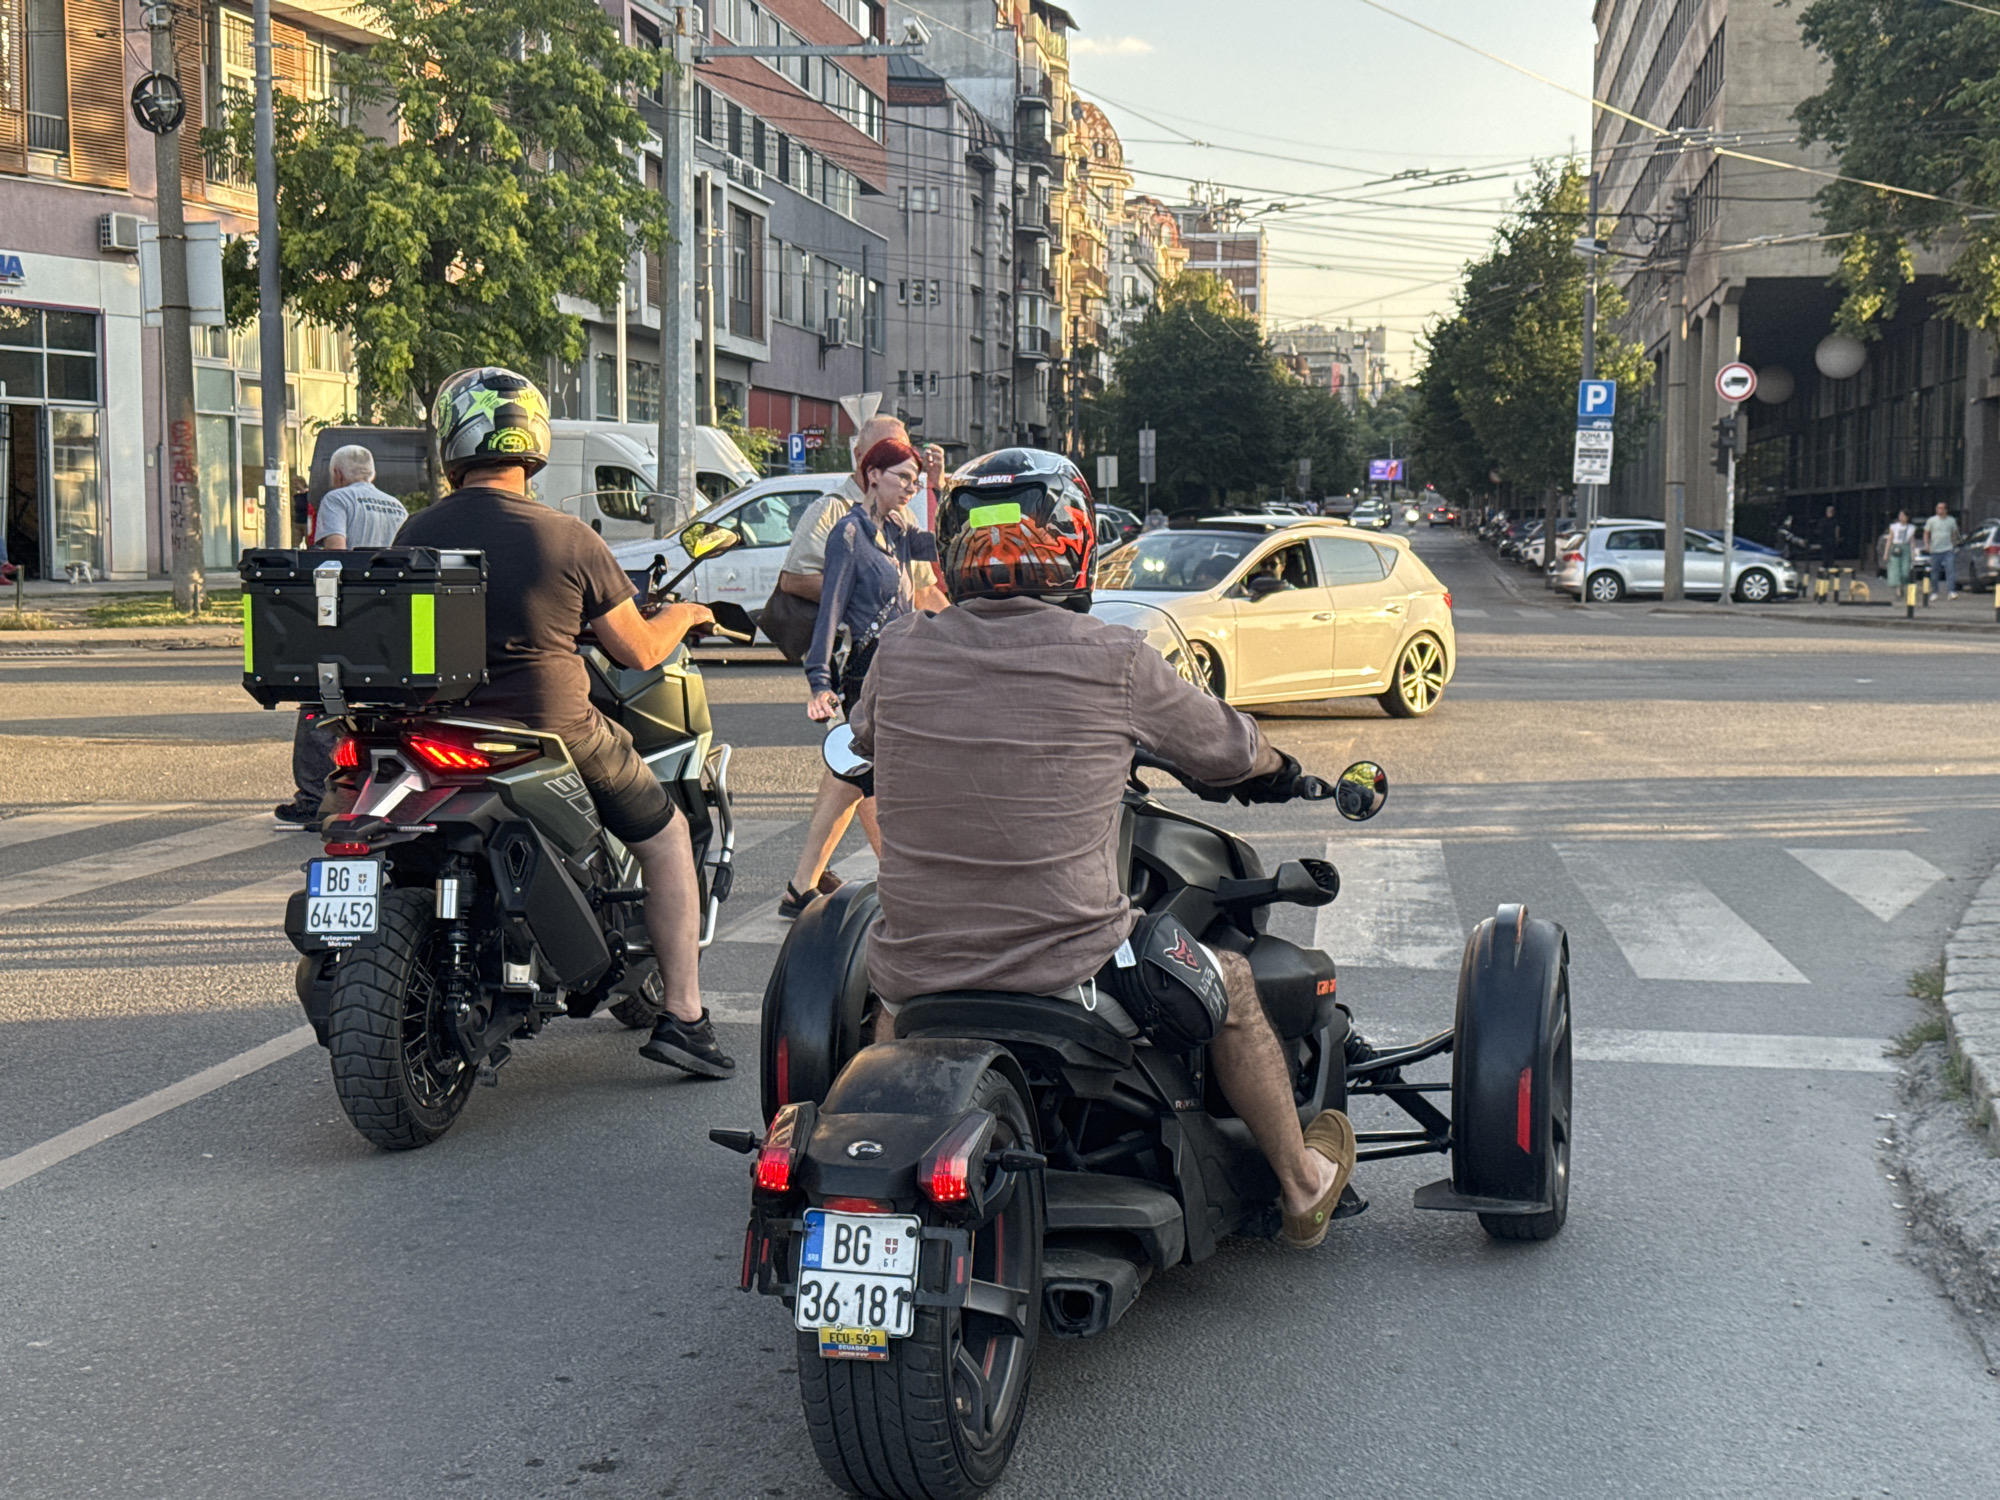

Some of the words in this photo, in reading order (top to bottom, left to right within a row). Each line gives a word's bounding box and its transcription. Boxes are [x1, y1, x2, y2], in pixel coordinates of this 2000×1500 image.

[1586, 385, 1607, 412] P
[792, 436, 802, 459] P
[977, 475, 1013, 485] MARVEL
[327, 866, 350, 892] BG
[807, 1253, 820, 1262] SRB
[833, 1223, 872, 1266] BG
[829, 1332, 878, 1346] ECU-593
